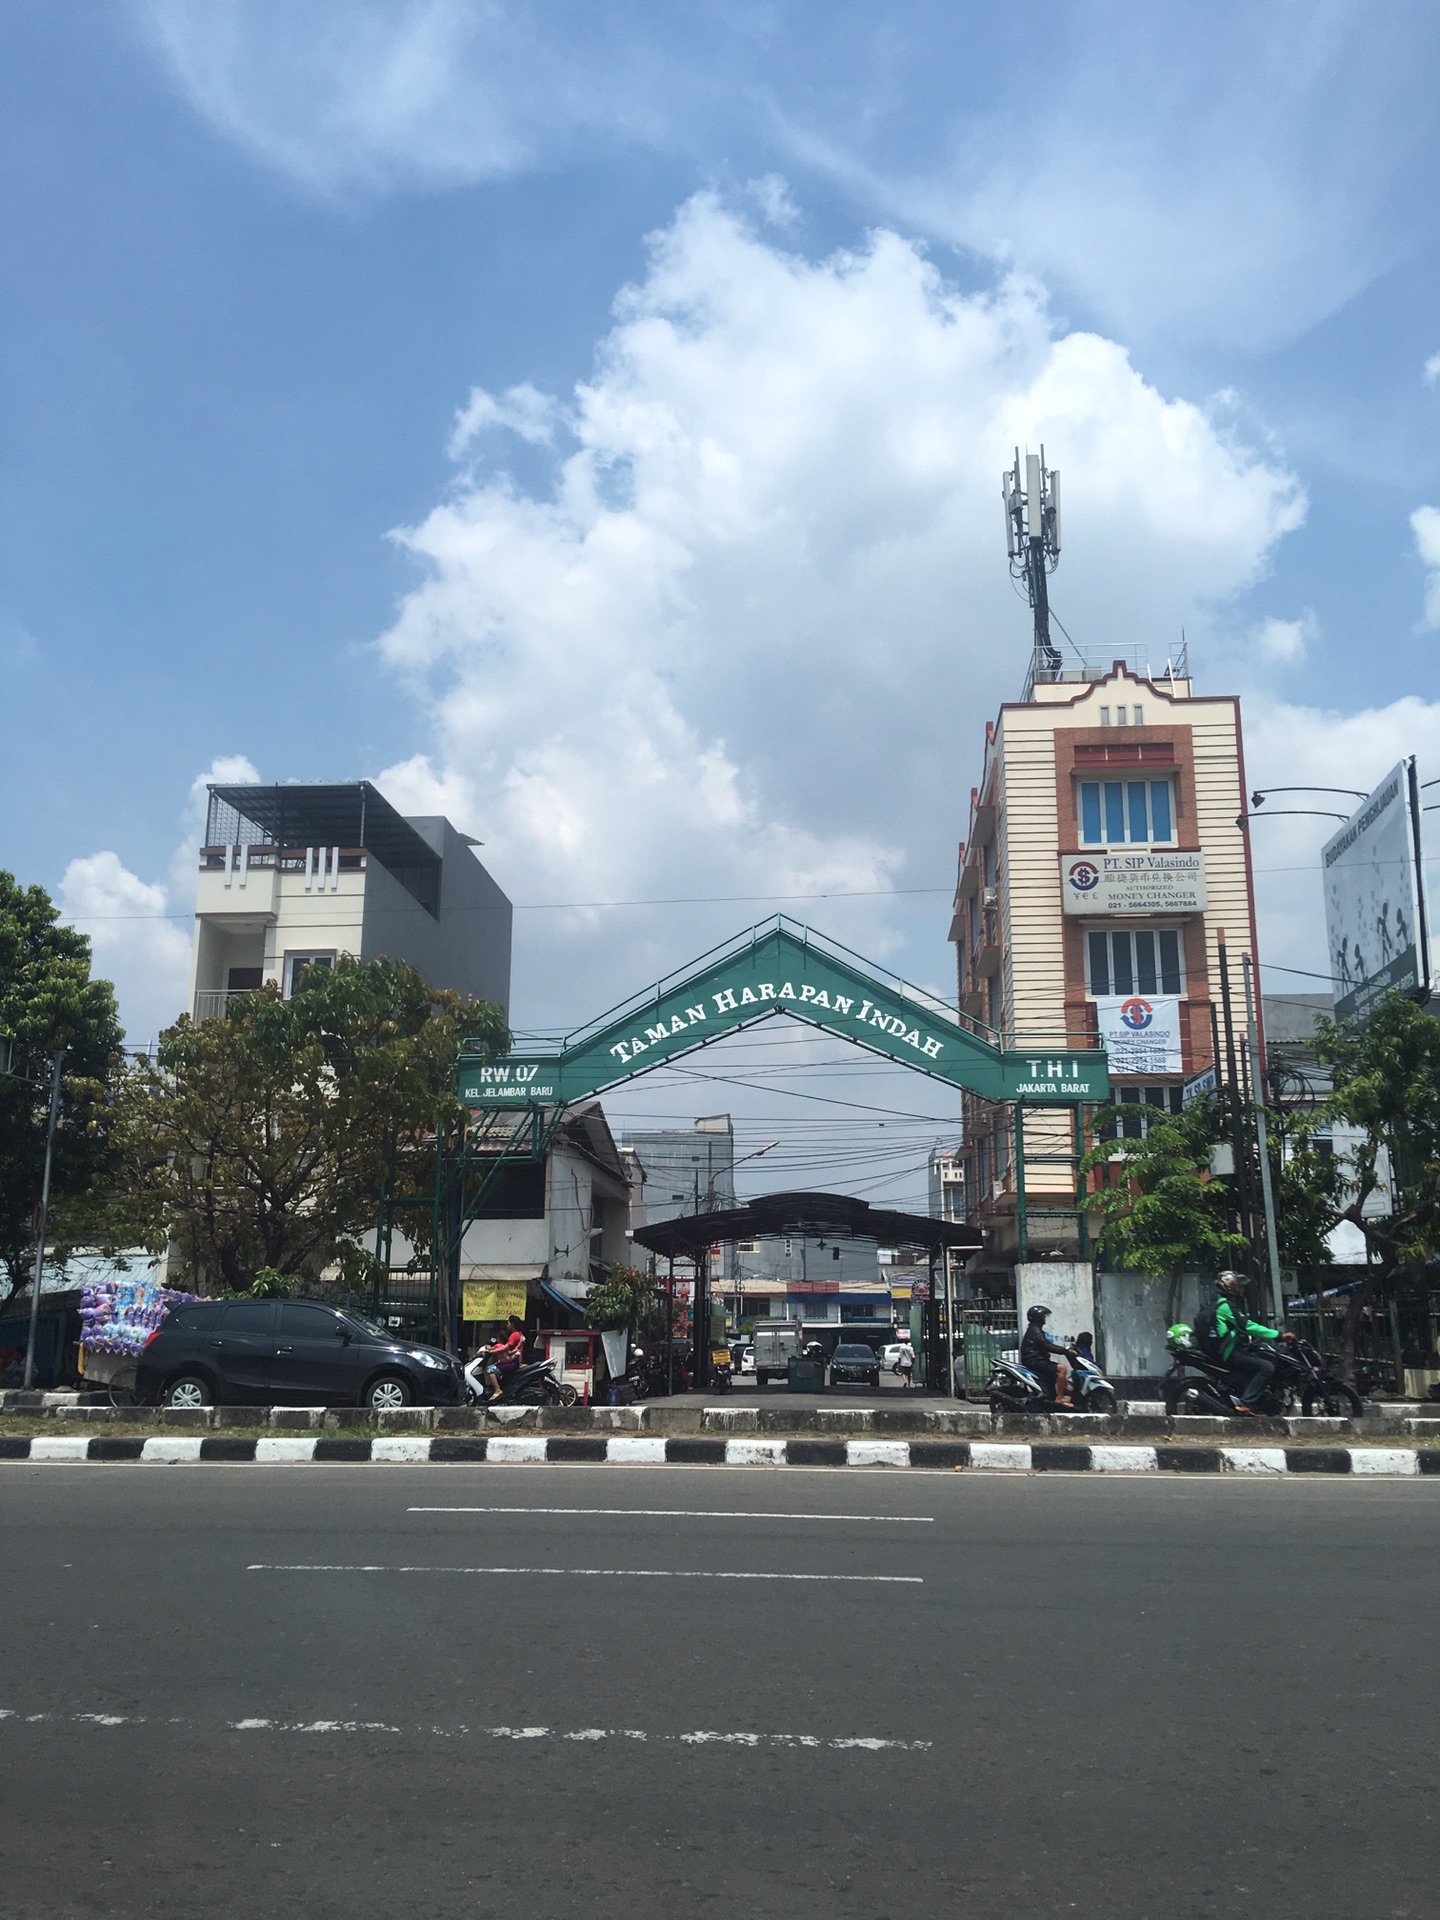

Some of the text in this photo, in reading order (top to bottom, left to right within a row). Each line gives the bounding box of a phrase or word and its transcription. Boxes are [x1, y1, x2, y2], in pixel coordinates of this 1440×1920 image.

[1104, 857, 1199, 869] PT. SIP Valasindo
[610, 982, 944, 1064] TAMAN HARAPAN INDAH
[530, 1087, 553, 1096] BARU
[1016, 1083, 1090, 1093] JAKARTA BARAT
